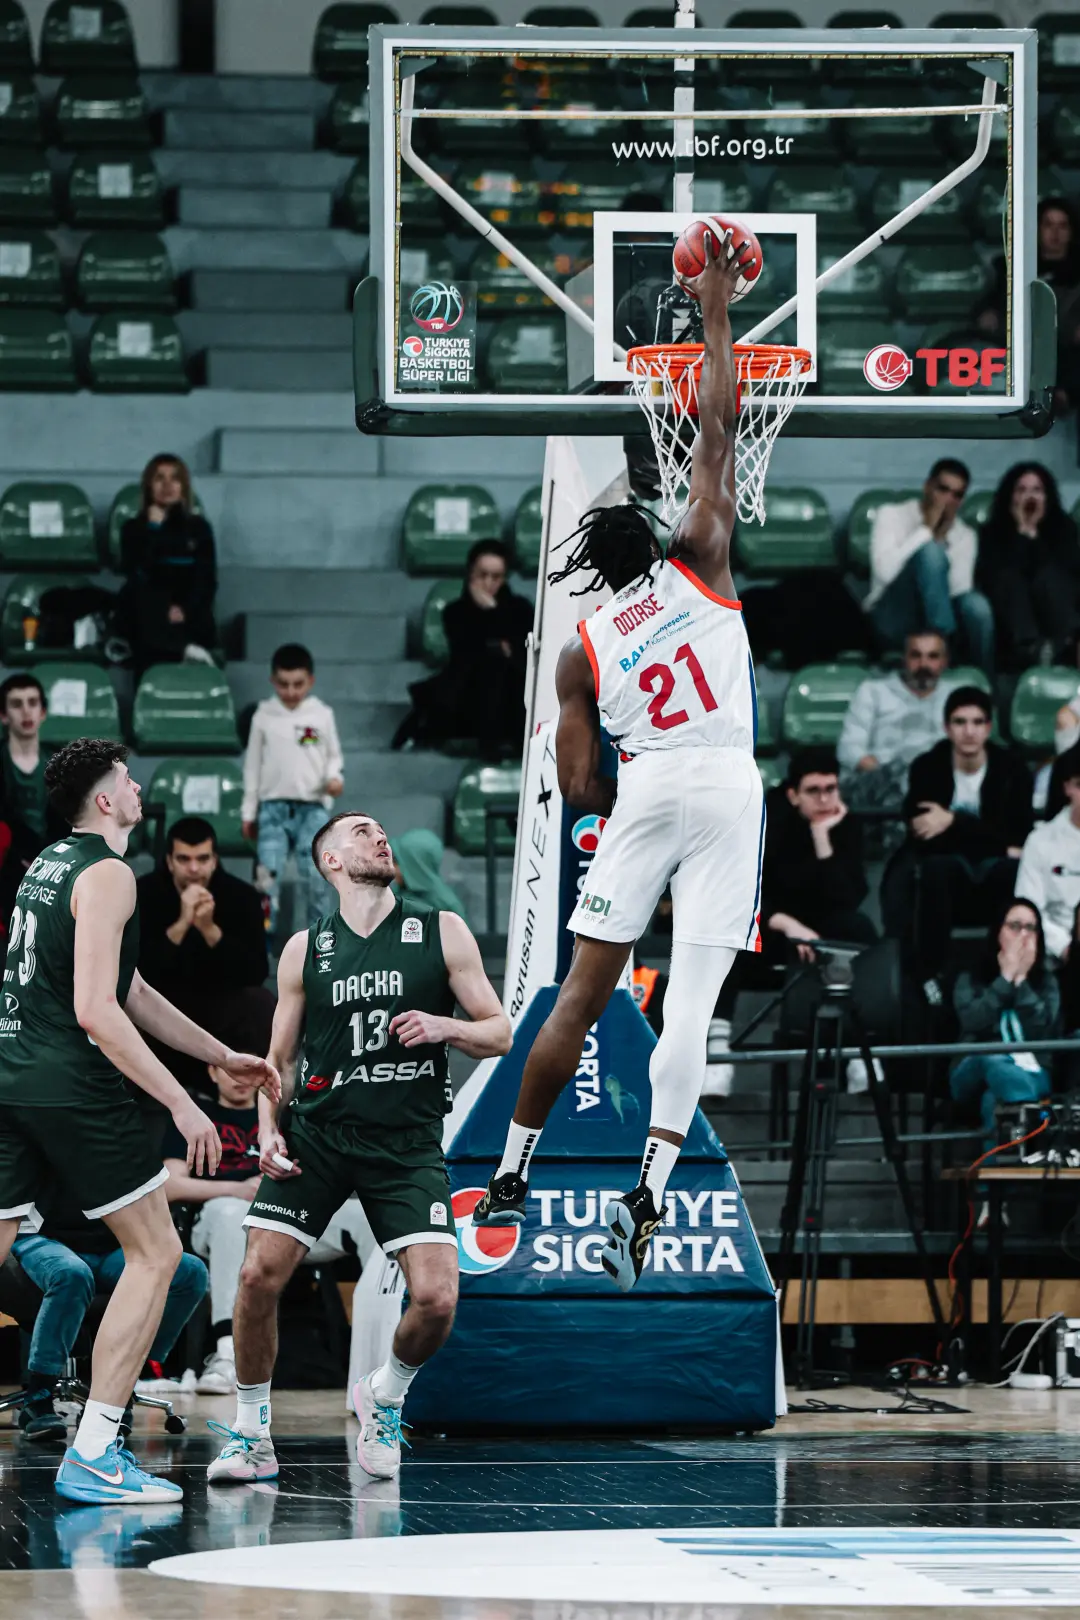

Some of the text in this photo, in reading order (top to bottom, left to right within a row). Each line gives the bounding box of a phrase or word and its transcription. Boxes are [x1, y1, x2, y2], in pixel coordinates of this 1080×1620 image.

[612, 135, 794, 160] www.tbf.org.tr
[400, 358, 474, 370] BASKETBOL
[402, 369, 444, 381] SÜPER
[916, 348, 1006, 387] TBF
[613, 593, 664, 636] ODIASE
[639, 643, 718, 730] 21
[510, 733, 556, 1017] Borusan NEXT
[333, 970, 403, 1007] DAÇKA
[348, 1009, 389, 1057] 13
[331, 1060, 435, 1089] LASSA
[253, 1201, 297, 1219] MEMORIAL
[531, 1235, 744, 1273] SiGRTA
